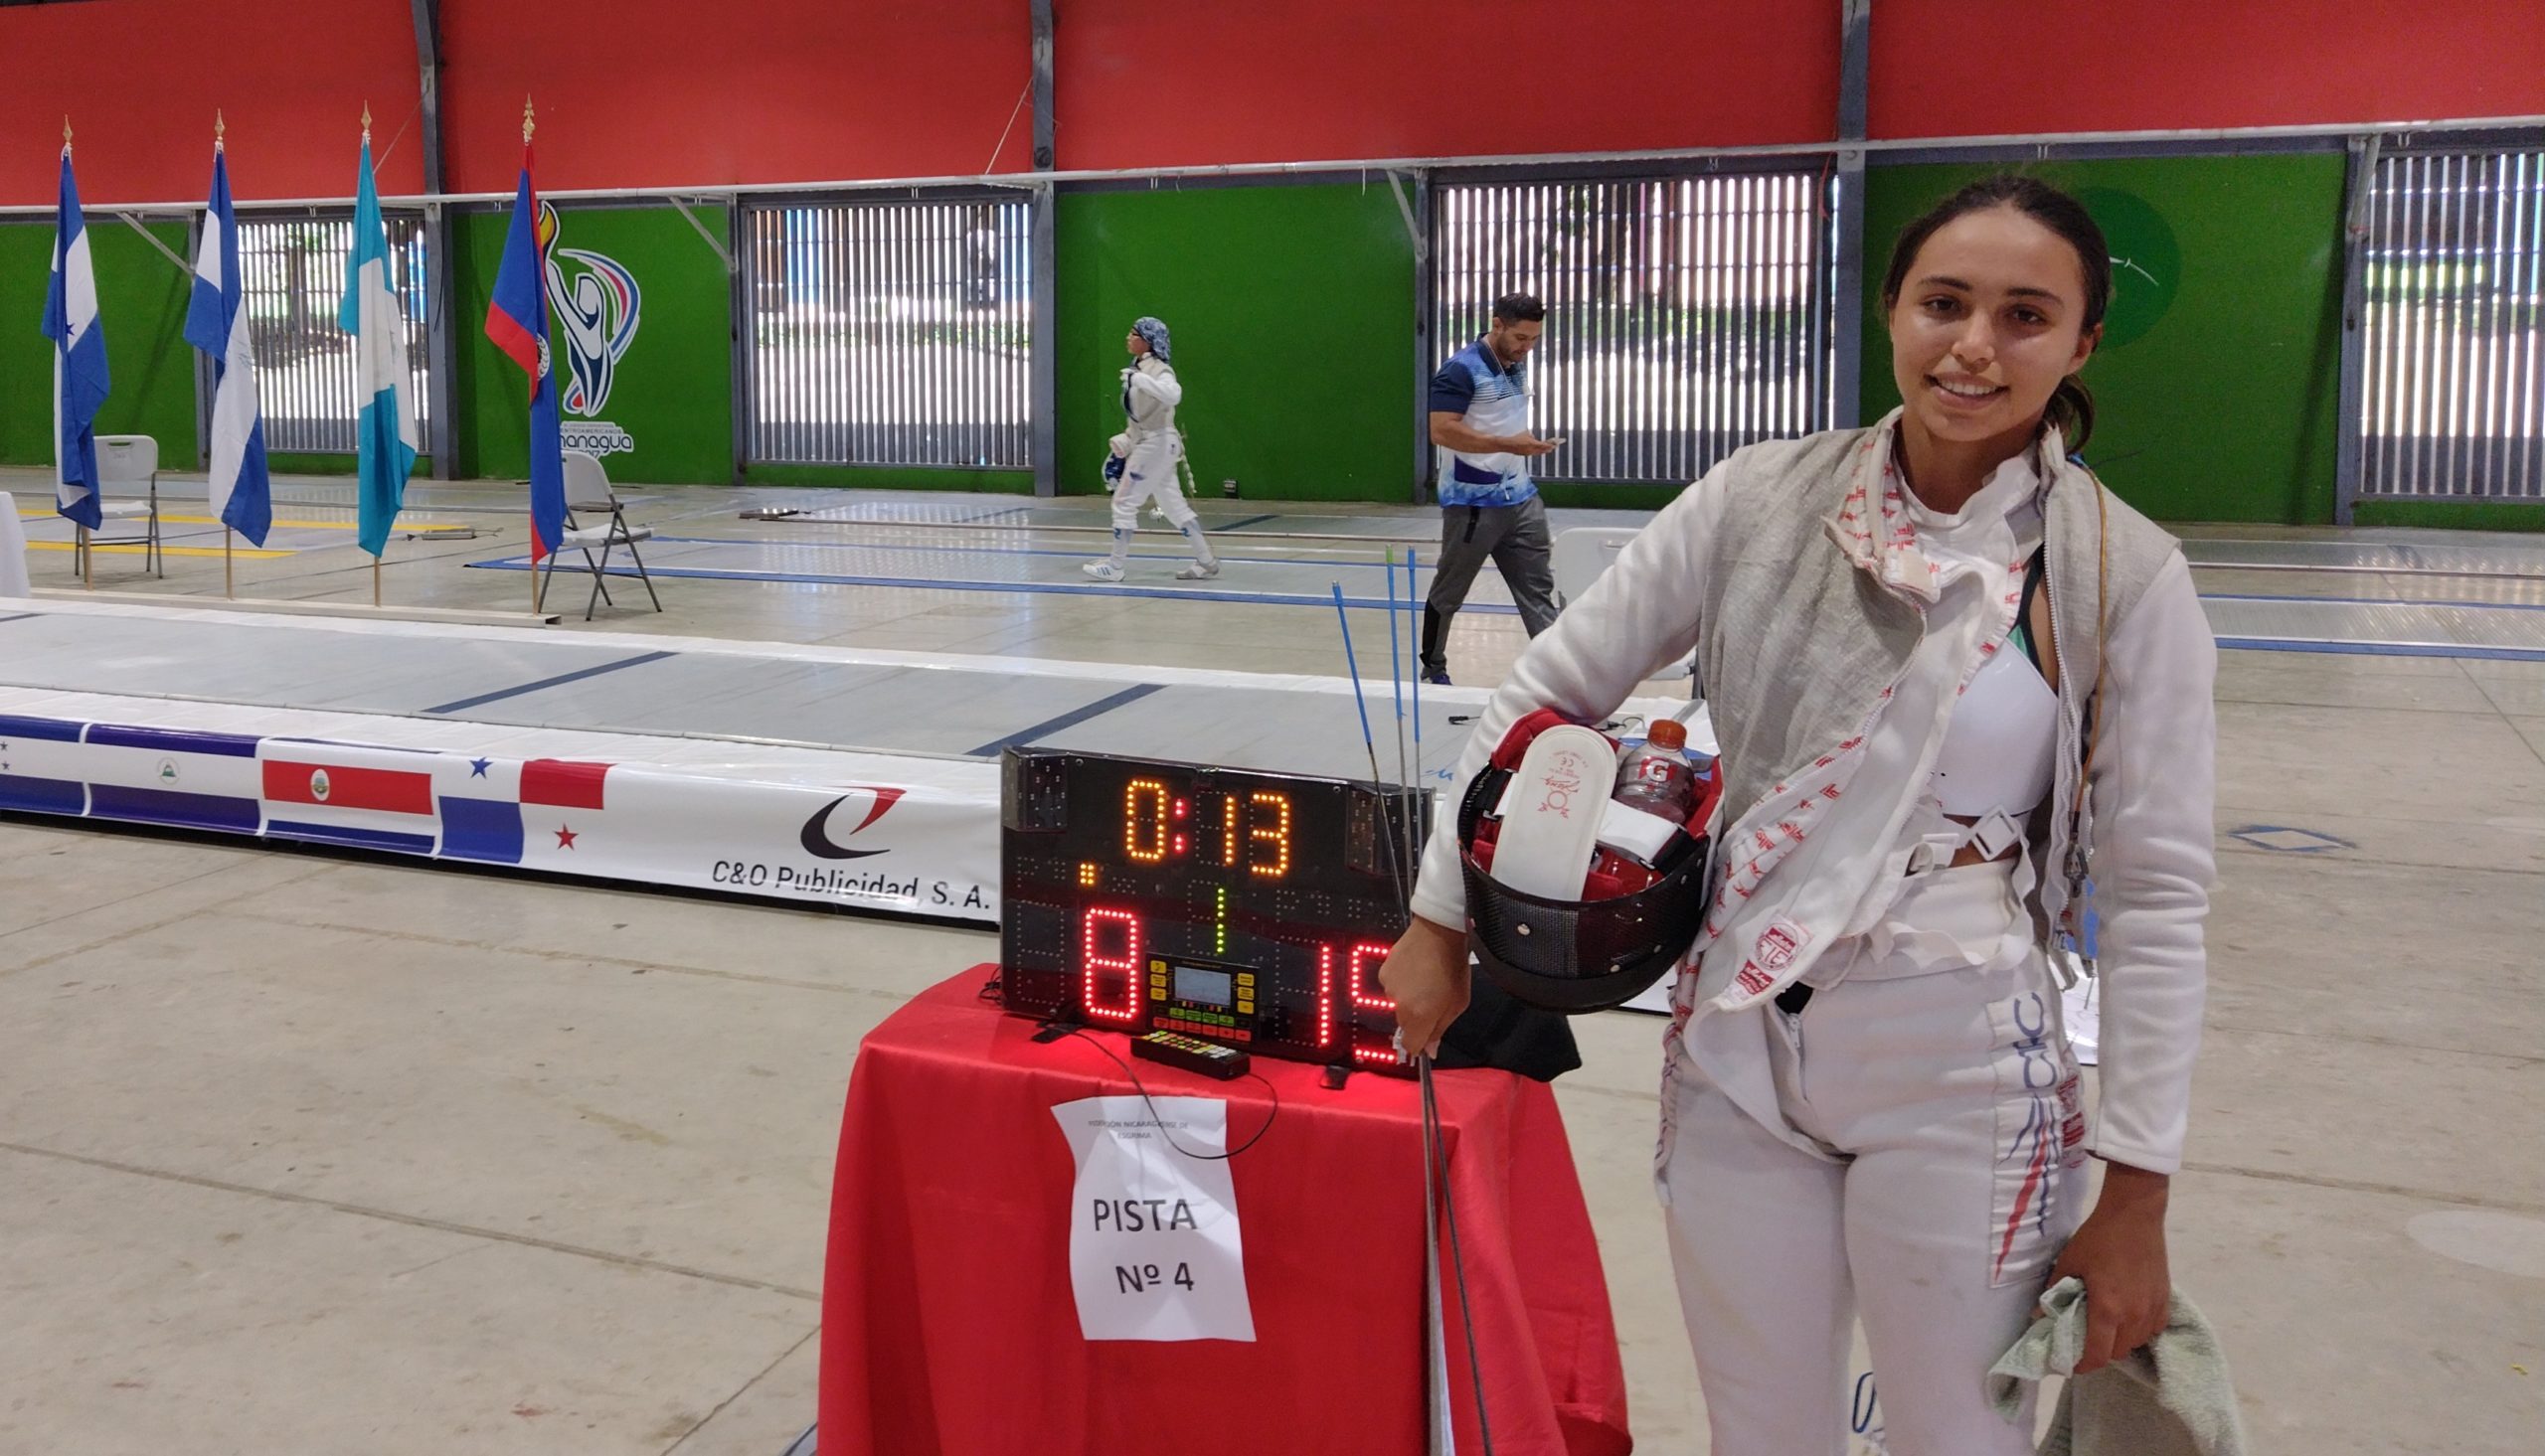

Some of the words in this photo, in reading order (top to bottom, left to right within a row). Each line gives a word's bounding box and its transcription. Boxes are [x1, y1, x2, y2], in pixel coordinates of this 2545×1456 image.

[1646, 759, 1670, 782] G
[713, 860, 767, 887] C&O
[775, 866, 919, 900] Publicidad
[932, 881, 955, 906] S.
[963, 885, 990, 909] A.
[1084, 907, 1137, 1021] 8
[1093, 1198, 1198, 1232] PISTA
[1174, 1262, 1195, 1292] 4
